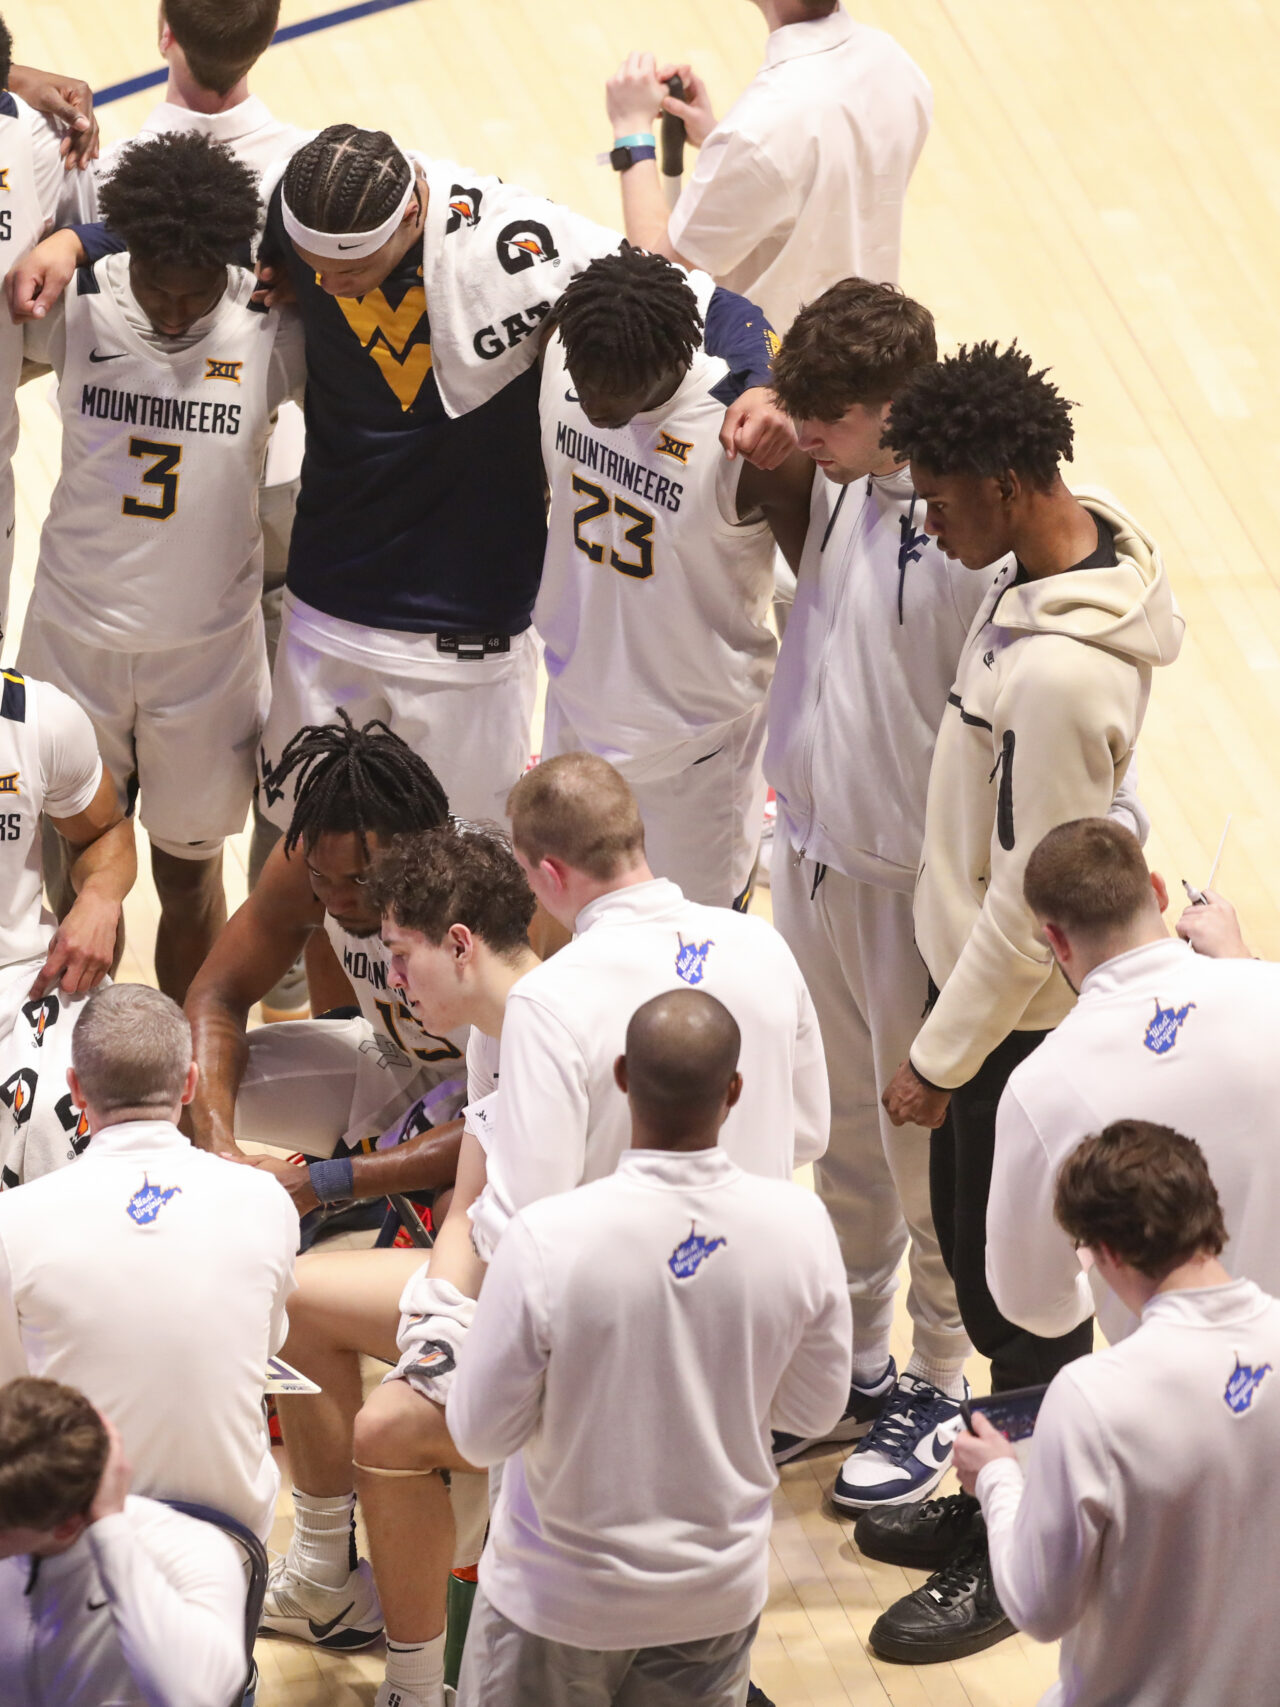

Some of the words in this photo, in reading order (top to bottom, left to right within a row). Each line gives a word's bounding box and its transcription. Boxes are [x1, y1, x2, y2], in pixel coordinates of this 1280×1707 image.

[81, 384, 241, 435] MOUNTAINEERS
[122, 435, 183, 522] 3
[555, 421, 684, 512] MOUNTAINEERS
[571, 472, 655, 580] 23
